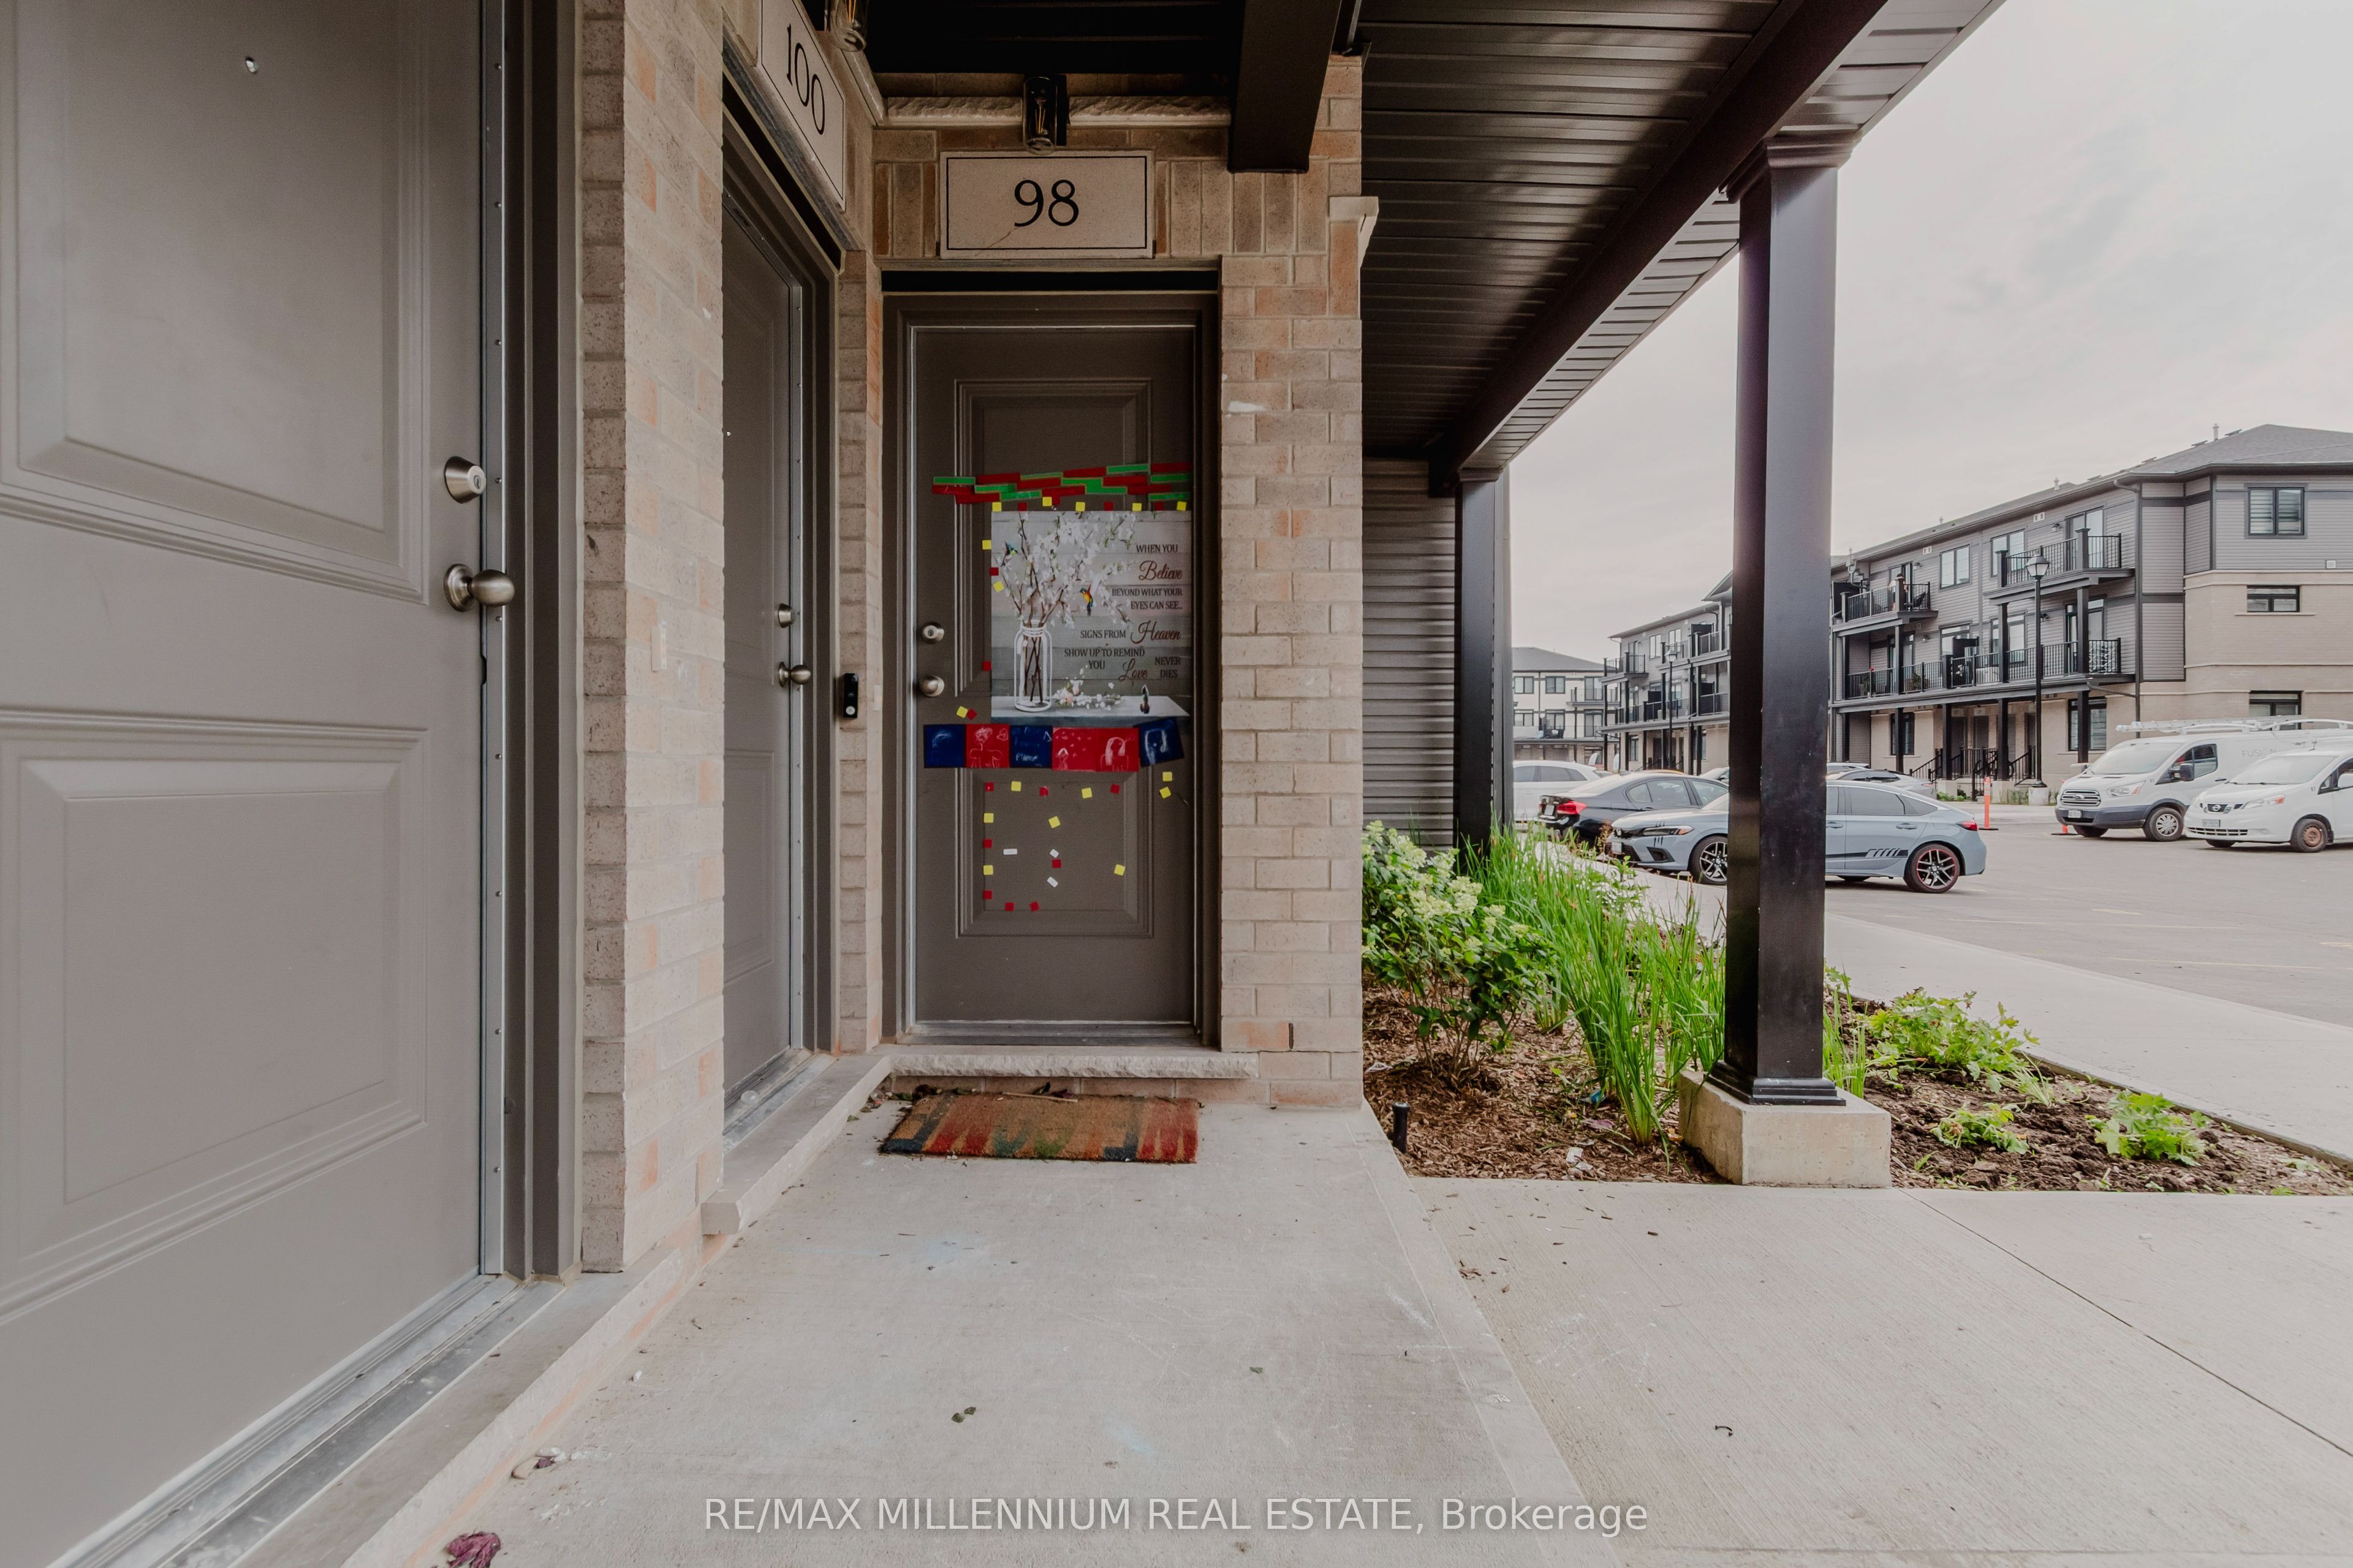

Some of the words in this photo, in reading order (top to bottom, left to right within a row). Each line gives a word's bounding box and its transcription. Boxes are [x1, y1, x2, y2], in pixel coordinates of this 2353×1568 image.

[786, 23, 825, 135] 100
[1014, 180, 1079, 227] 98
[1136, 544, 1161, 553] WHEN
[1162, 544, 1178, 553] YOU
[1138, 560, 1183, 581] Believe
[1131, 601, 1149, 610] EYES
[1150, 601, 1165, 610] CAN
[1080, 630, 1102, 638] SIGNS
[1104, 630, 1126, 638] FROM
[1130, 620, 1181, 644] Heaven
[1064, 648, 1089, 657] SHOW
[1089, 648, 1101, 657] UP
[1101, 648, 1112, 657] TO
[1113, 648, 1145, 657] REMIND
[1088, 660, 1105, 670] YOU
[1154, 657, 1181, 665] NEVER
[1118, 657, 1148, 686] Love
[2241, 748, 2276, 757] FUSION
